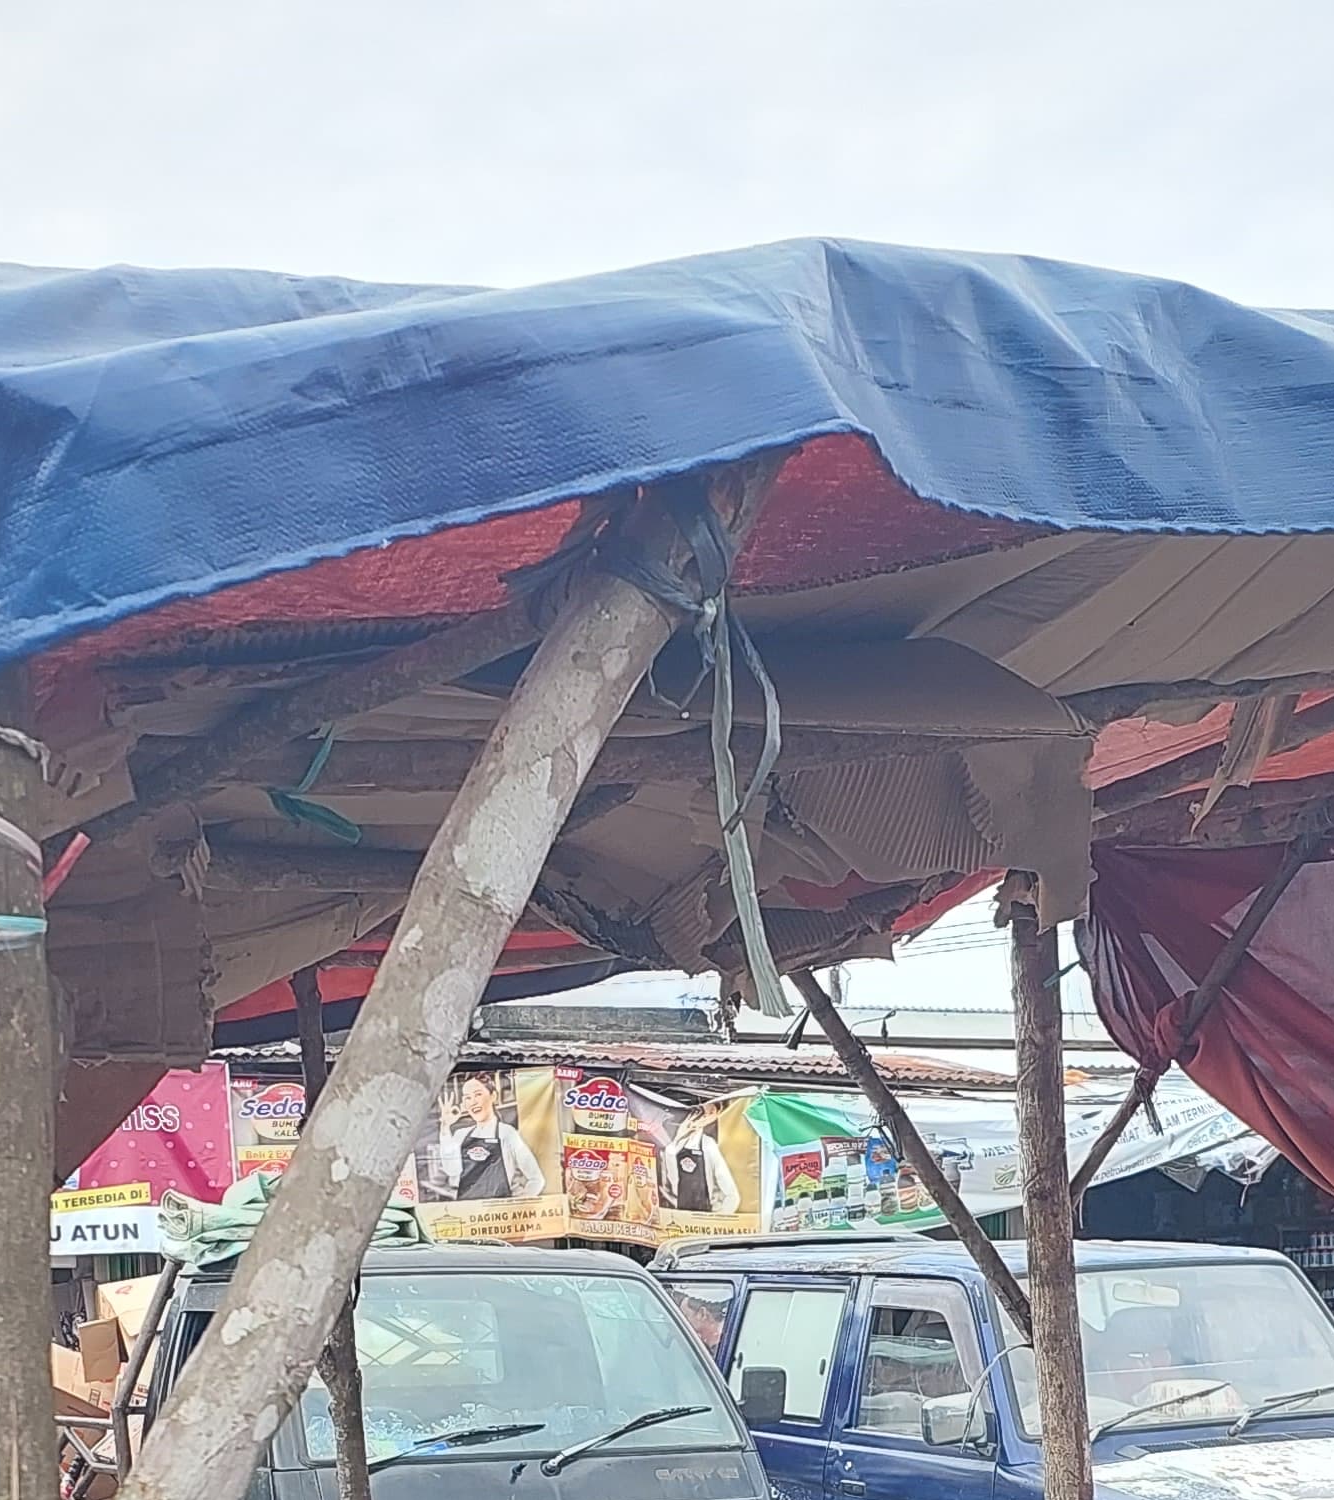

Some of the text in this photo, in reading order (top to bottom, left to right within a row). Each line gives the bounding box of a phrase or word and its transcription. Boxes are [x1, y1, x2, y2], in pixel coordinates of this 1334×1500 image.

[232, 1079, 253, 1089] ARU
[240, 1096, 306, 1119] Seda
[274, 1150, 290, 1159] EX
[63, 1192, 127, 1208] TERSEDIA
[131, 1189, 143, 1200] DI
[469, 1211, 510, 1222] DAGING
[511, 1209, 538, 1221] AYAM
[71, 1222, 140, 1241] ATUN
